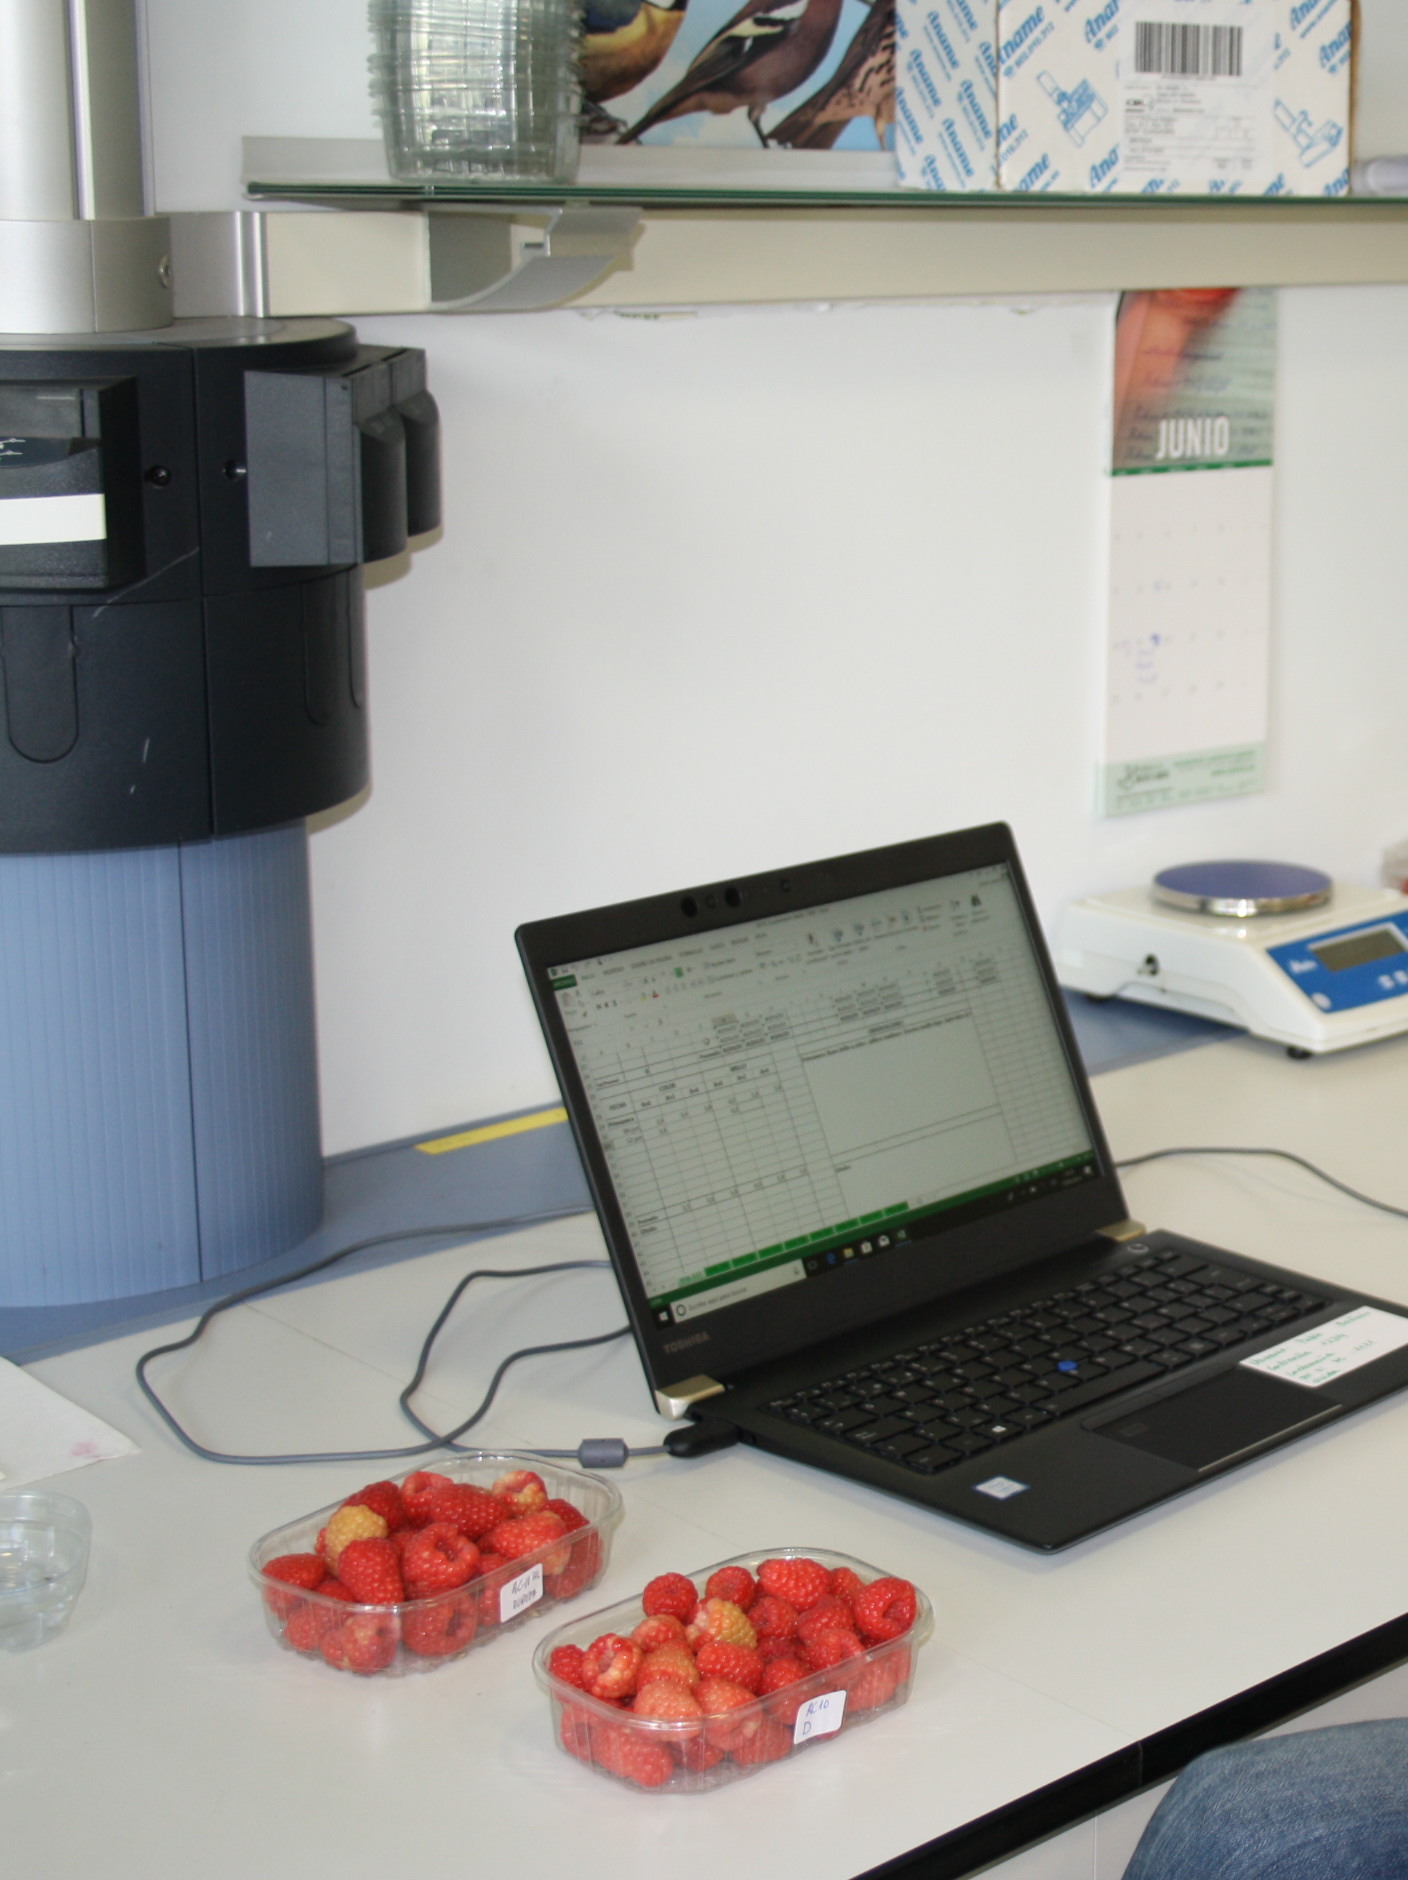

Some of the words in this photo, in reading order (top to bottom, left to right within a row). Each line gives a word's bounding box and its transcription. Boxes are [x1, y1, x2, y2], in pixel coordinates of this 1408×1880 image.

[927, 10, 959, 69] Aname
[1085, 0, 1120, 43] Ana
[909, 48, 942, 108] Aname
[961, 79, 993, 139] Aname
[943, 118, 974, 178] Aname
[1090, 143, 1120, 189] Ana
[1017, 153, 1051, 191] ame
[1156, 417, 1229, 460] JUNIO
[663, 1331, 711, 1355] TOSHIBA
